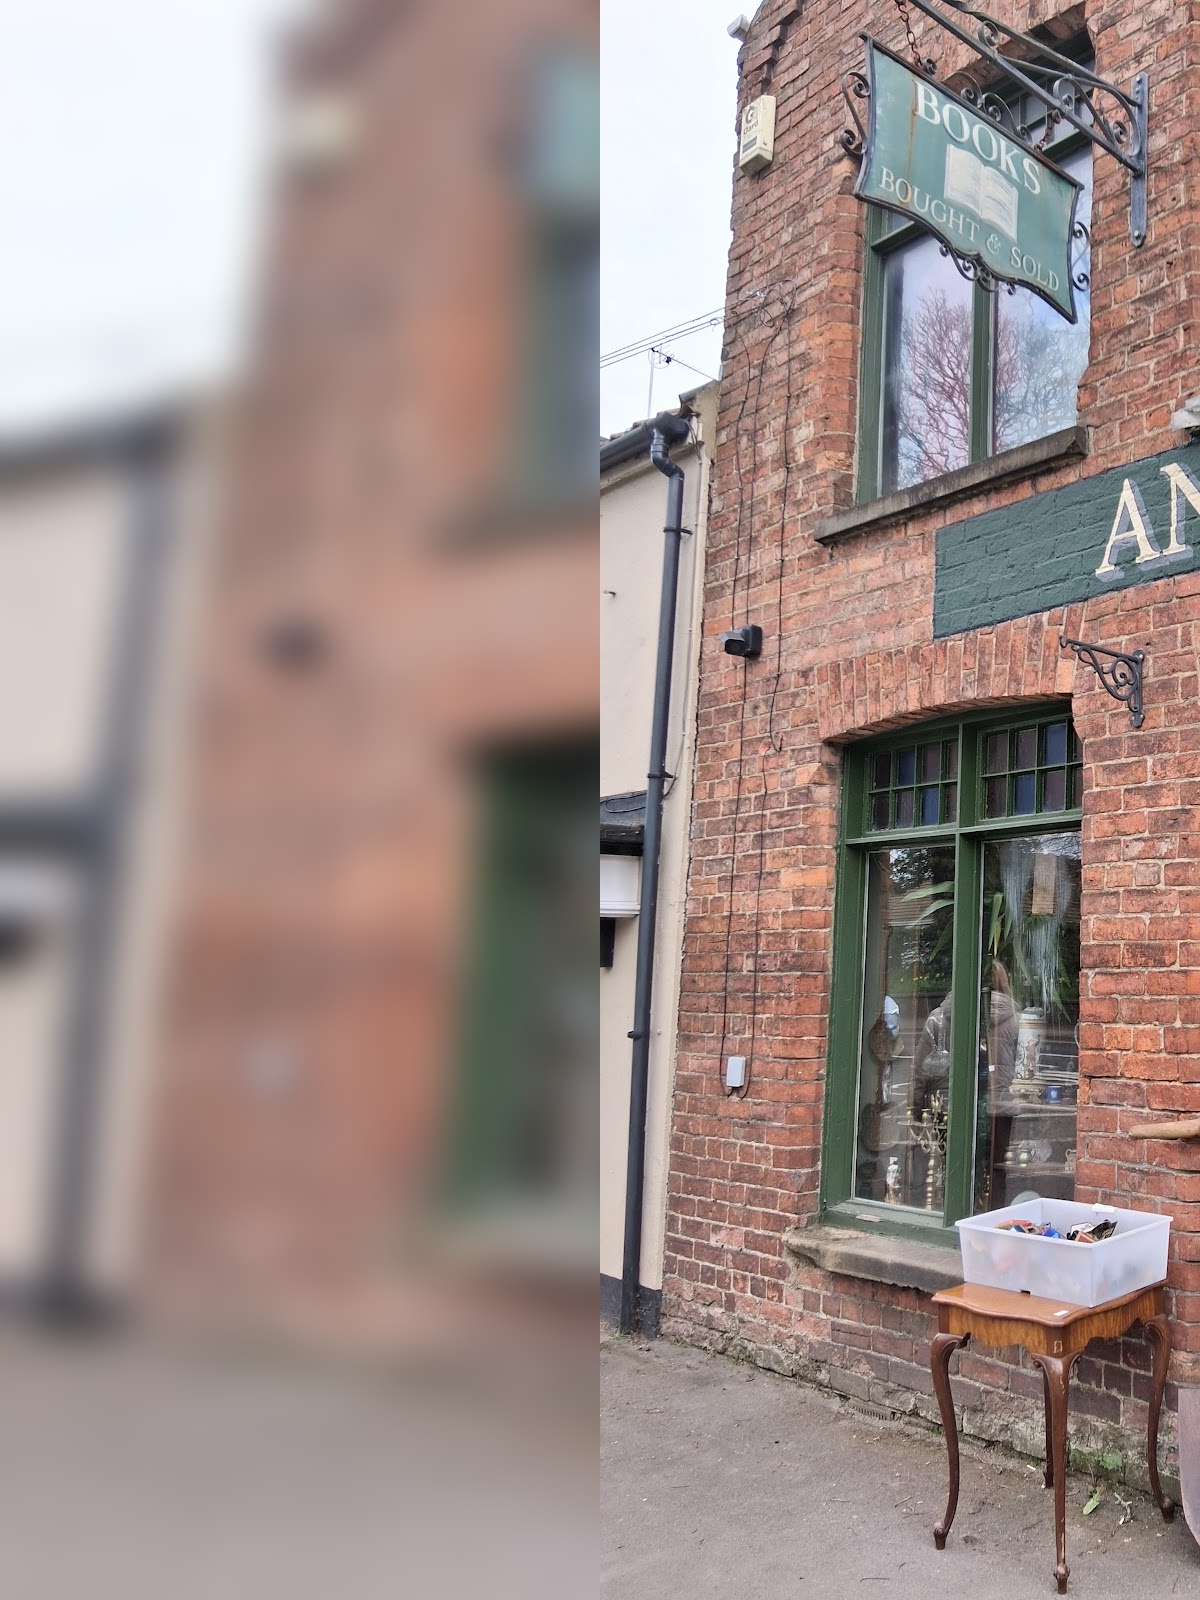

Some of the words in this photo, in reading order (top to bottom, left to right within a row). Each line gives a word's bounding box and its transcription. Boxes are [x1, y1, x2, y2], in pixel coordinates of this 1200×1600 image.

[914, 80, 1041, 195] BOOKS
[879, 166, 980, 243] BOUGHT
[985, 232, 1002, 255] &
[1010, 246, 1060, 292] SOLD
